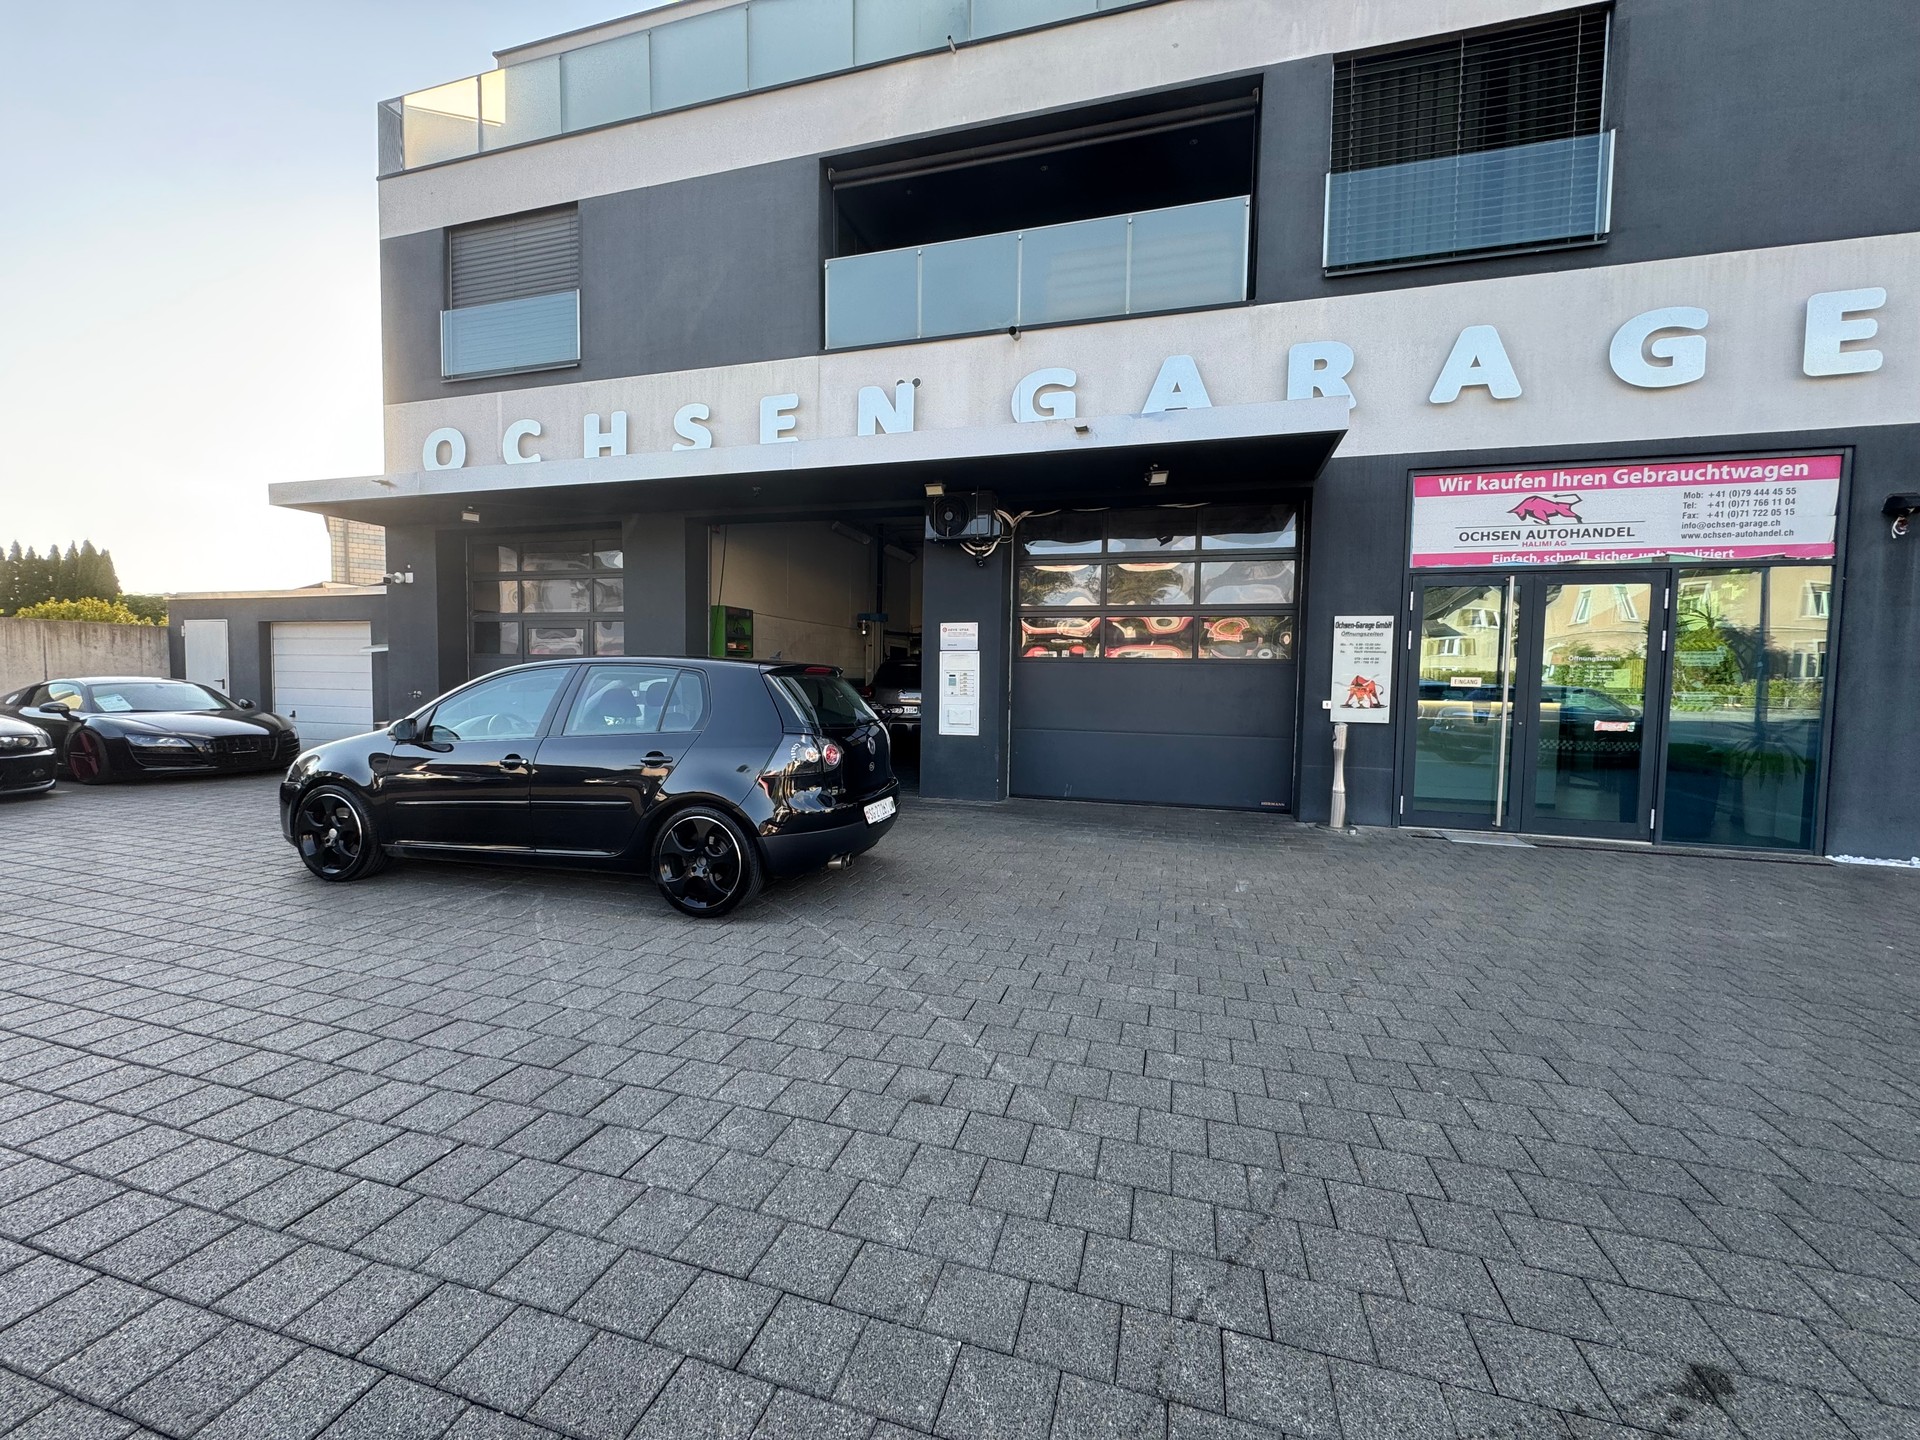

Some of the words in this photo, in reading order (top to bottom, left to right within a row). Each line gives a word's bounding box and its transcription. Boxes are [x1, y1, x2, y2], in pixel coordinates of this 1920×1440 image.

[423, 383, 915, 471] OCHSEN
[1012, 287, 1886, 423] GARAGE
[1439, 478, 1472, 492] Wir
[1476, 475, 1546, 491] kaufen
[1552, 471, 1607, 487] Ihren
[1613, 463, 1809, 485] Gebrauchtwagen
[1683, 491, 1704, 499] Mob:
[1708, 490, 1726, 498] +41
[1729, 489, 1752, 498] (0)79
[1753, 488, 1770, 496] 444
[1772, 488, 1783, 496] 45
[1785, 487, 1797, 495] 55
[1682, 501, 1697, 509] Tel:
[1707, 500, 1725, 508] +41
[1728, 499, 1750, 509] (0)71
[1772, 498, 1782, 506] 11
[1785, 497, 1796, 505] 04
[1682, 511, 1699, 519] Fax:
[1727, 510, 1749, 519] (0)71
[1752, 509, 1768, 517] 722
[1785, 508, 1795, 516] 15
[1681, 519, 1781, 530] info@ochsen-garage.ch
[1459, 530, 1521, 542] OCHSEN
[1526, 527, 1636, 540] AUTOHANDEL
[1680, 529, 1794, 540] www.ochsen-autohandel.ch
[1492, 553, 1541, 564] Einfach,
[1335, 621, 1375, 630] Ochsen-Garage
[1375, 621, 1392, 629] GmbH
